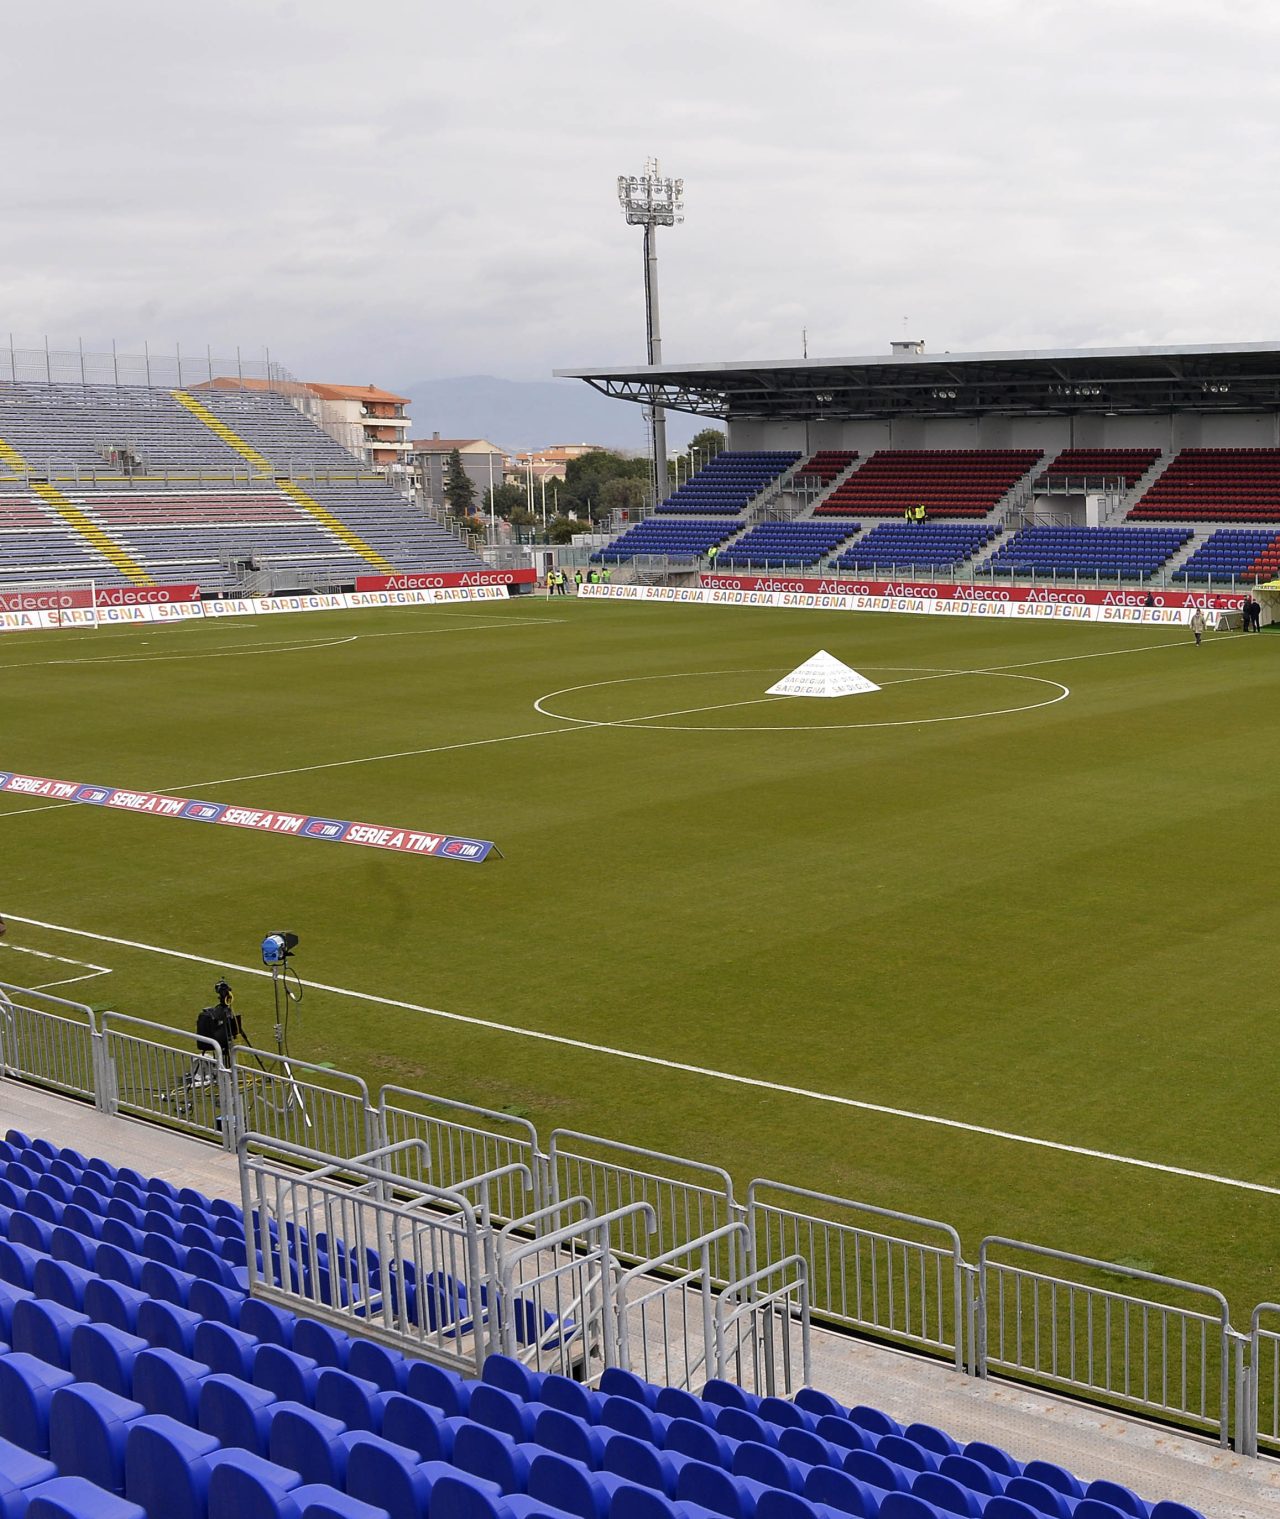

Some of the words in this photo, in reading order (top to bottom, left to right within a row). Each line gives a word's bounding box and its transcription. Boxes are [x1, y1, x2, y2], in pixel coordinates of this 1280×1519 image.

[385, 576, 443, 589] Adecco
[459, 572, 513, 586] Adecco
[96, 590, 169, 605] Adecco
[352, 590, 425, 605] SARDEGNA
[436, 587, 503, 601] SARDEGNA
[583, 585, 637, 598] SARDEGNA
[646, 588, 704, 601] SARDEGNA
[713, 591, 773, 604] SARDEGNA
[754, 578, 804, 593] Adecco
[818, 581, 869, 595] Adecco
[884, 584, 938, 598] Adecco
[953, 586, 1009, 601] Adecco
[1026, 589, 1085, 604] Adecco
[1102, 592, 1164, 607] Adeco
[261, 596, 340, 611] SARDEGNA
[784, 593, 847, 607] SARDEGNA
[857, 597, 924, 611] SARDEGNA
[158, 602, 247, 617] SARDEGNA
[935, 601, 1005, 615] SARDEGNA
[1017, 604, 1091, 618] SARDEGNA
[1103, 607, 1182, 622] SARDEGNA
[47, 608, 144, 624] SARDEGNA
[7, 777, 44, 792] SERIE
[40, 781, 52, 794] A
[51, 783, 78, 798] TIM
[89, 791, 105, 800] TIM
[109, 792, 148, 808] SERIE
[141, 797, 157, 811] A
[157, 799, 185, 814] TIM
[198, 807, 216, 817] TIM
[221, 809, 264, 825] SERIE
[257, 814, 273, 828] A
[273, 816, 304, 832] TIM
[320, 825, 339, 835] TIM
[346, 826, 393, 844] SERIE
[387, 832, 406, 847] A
[406, 834, 440, 852] TIM
[458, 844, 480, 856] TIM
